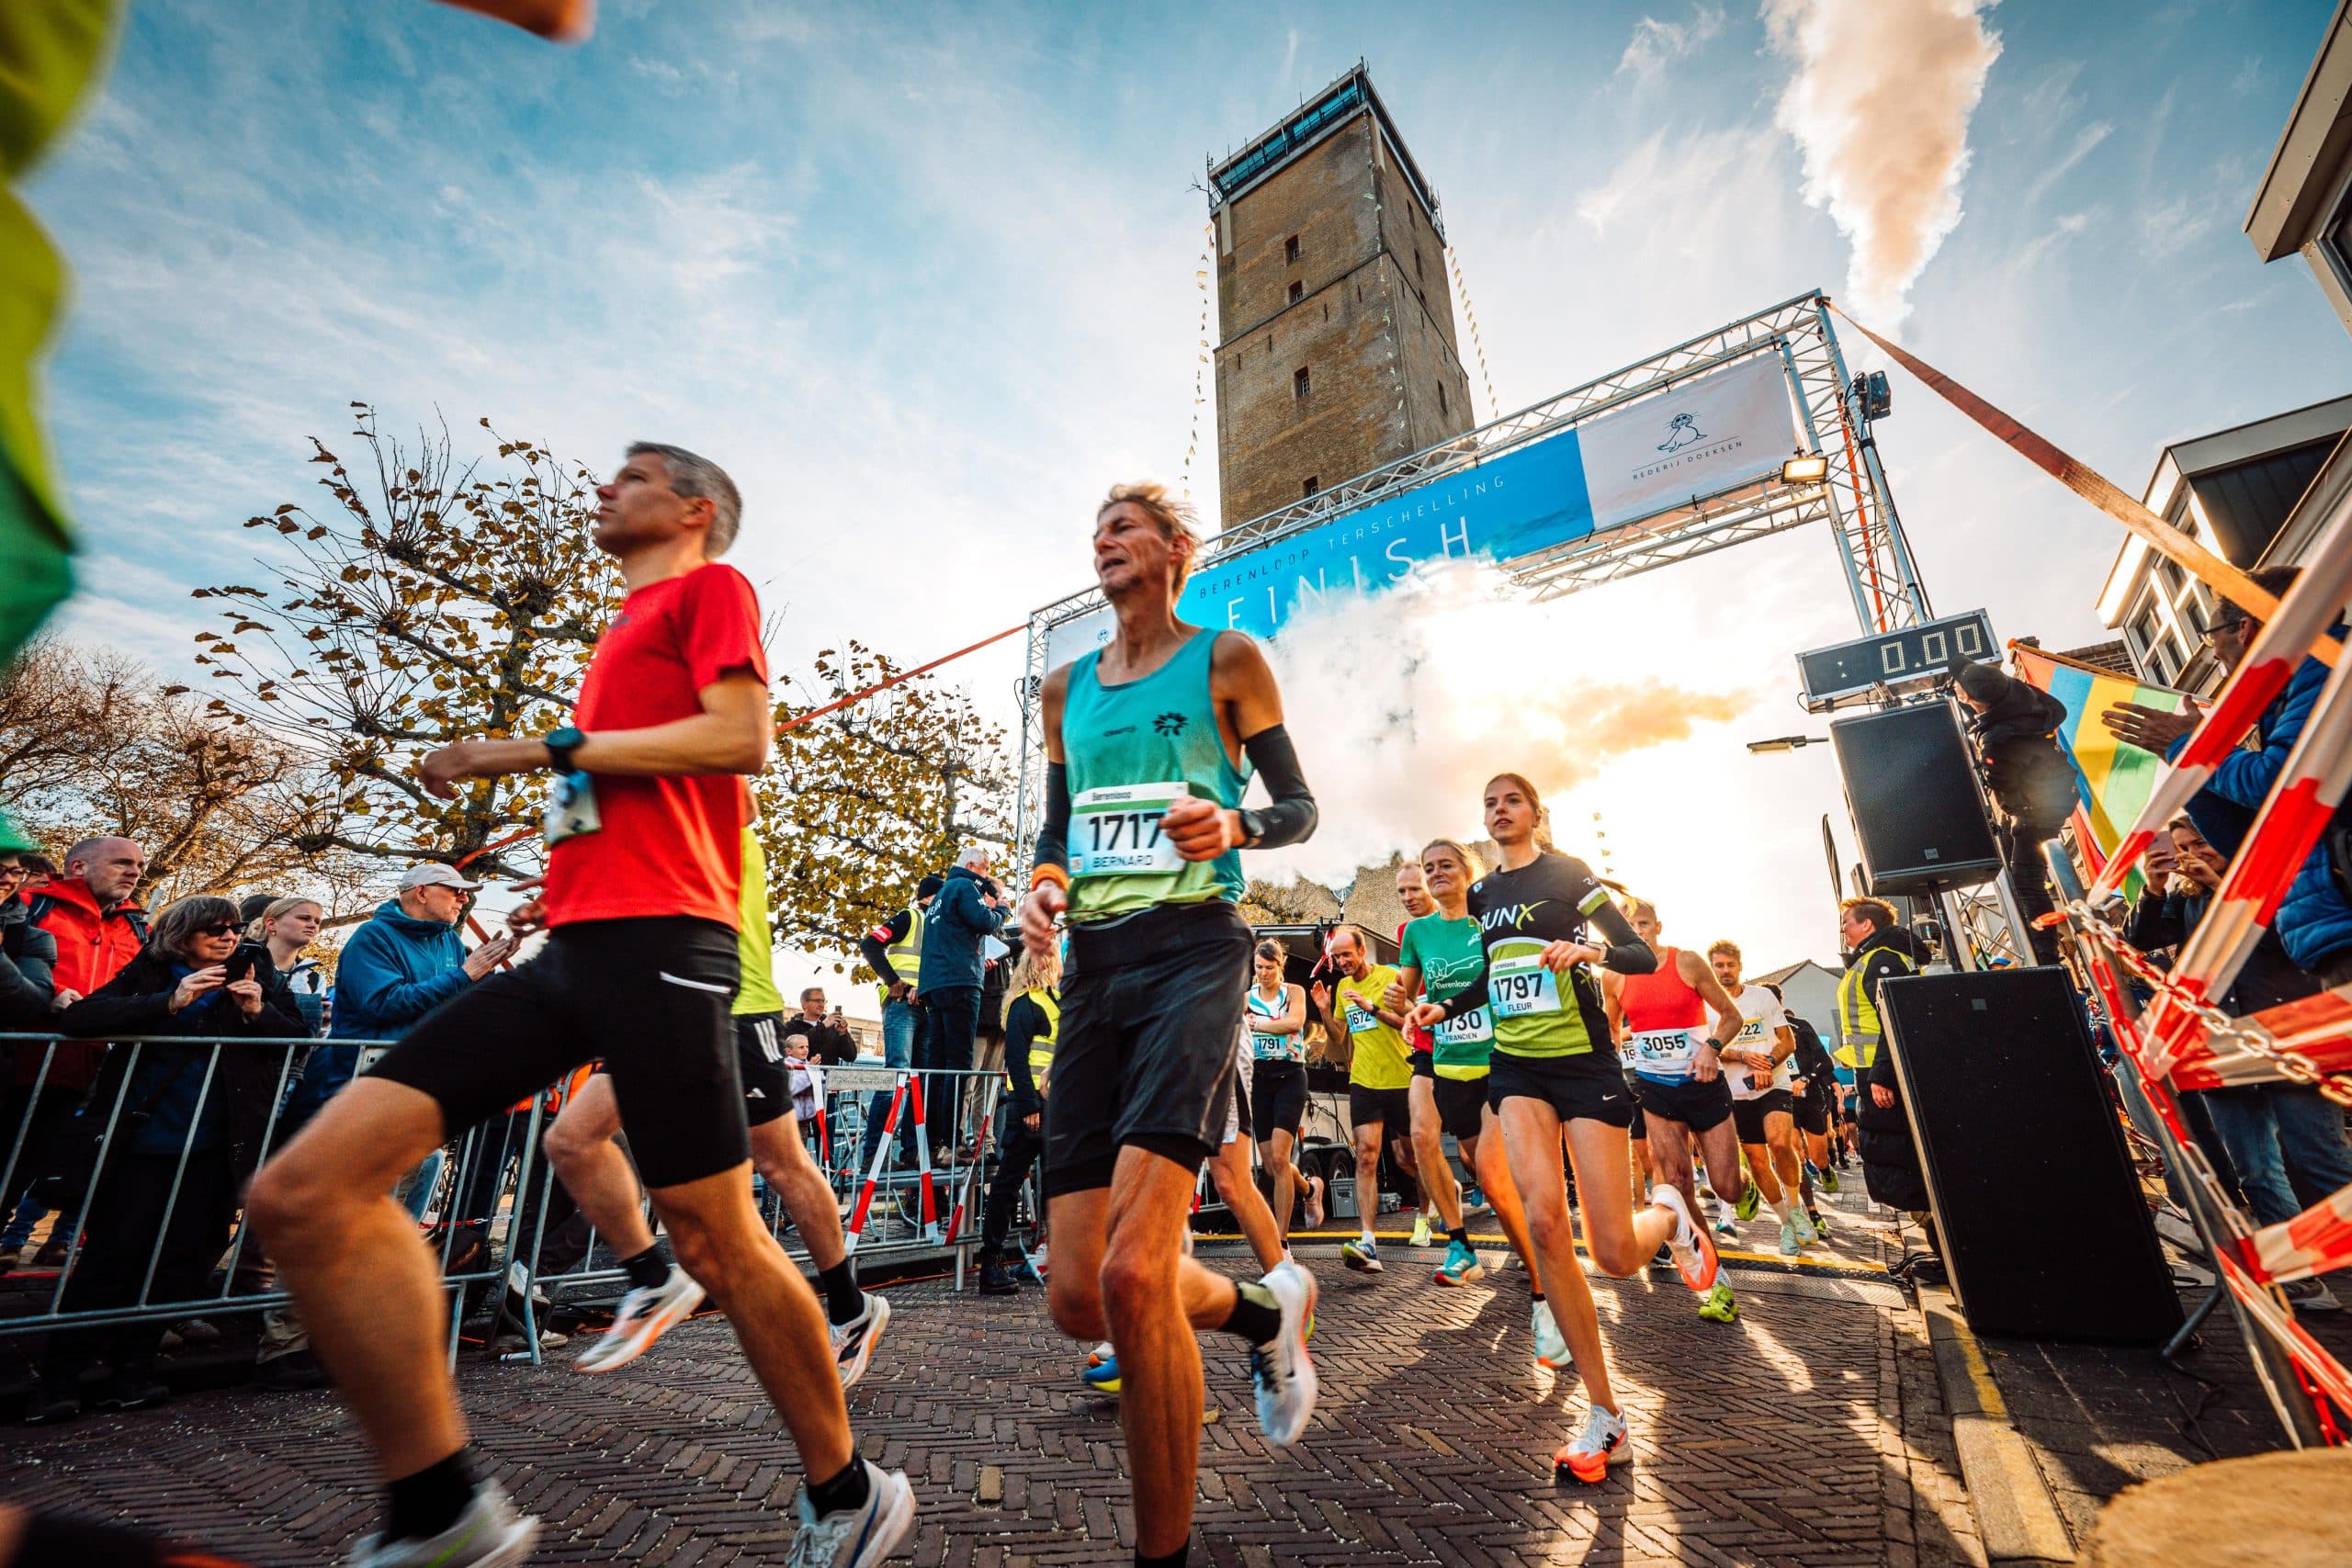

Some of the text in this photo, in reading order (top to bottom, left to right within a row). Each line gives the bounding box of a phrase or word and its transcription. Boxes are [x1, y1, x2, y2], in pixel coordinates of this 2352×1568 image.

[1633, 440, 1743, 480] REDERIJ DOEKSEN
[1200, 475, 1506, 599] BERENLOOP TERSCHELLING
[1227, 516, 1471, 630] FINISH
[1089, 811, 1166, 852] 1717
[1092, 854, 1153, 868] BERNARD
[1493, 973, 1543, 1002] 1797
[1508, 1002, 1532, 1012] FLEUR
[1349, 1010, 1372, 1026] 1672
[1441, 1010, 1482, 1033] 1730
[1258, 1038, 1280, 1050] 1791
[1445, 1032, 1477, 1043] FRANCIEN
[1642, 1034, 1686, 1052] 3055
